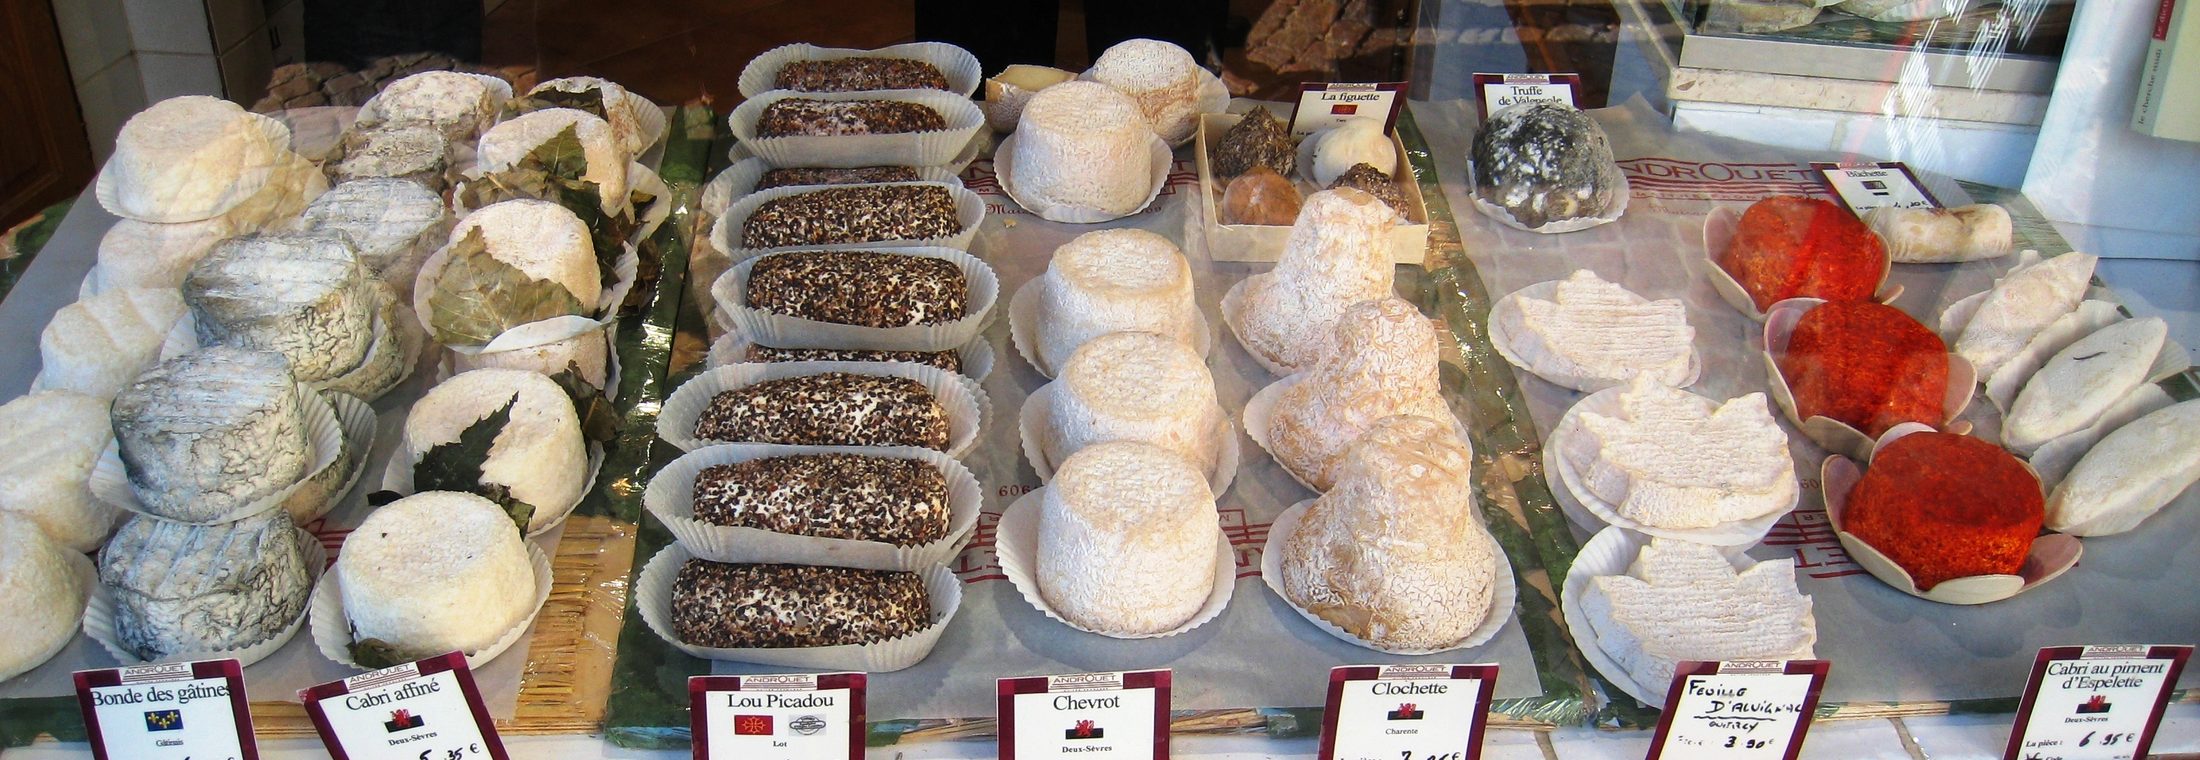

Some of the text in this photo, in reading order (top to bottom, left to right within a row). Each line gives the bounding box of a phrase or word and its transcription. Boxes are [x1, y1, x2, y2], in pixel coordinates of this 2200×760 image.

[1321, 92, 1380, 103] La figuette
[1511, 86, 1543, 96] Truffe
[1498, 96, 1512, 106] de
[1618, 161, 1814, 183] NDROUET
[998, 484, 1033, 498] 909
[123, 663, 187, 677] ANDROUET
[348, 662, 411, 684] ANDROUET
[1384, 665, 1447, 673] ANDROUET
[2047, 661, 2164, 677] Cabri au piment
[744, 674, 811, 684] ANDROUET
[1052, 673, 1117, 685] ANDROUET
[2062, 675, 2144, 692] d'Espelette
[91, 682, 231, 707] Bonde des gâtines
[345, 687, 391, 711] Cabri
[393, 676, 441, 701] affiné
[1371, 681, 1448, 696] Clochette
[727, 692, 835, 709] Lou Picadou
[1053, 694, 1120, 711] Chevrot
[2063, 716, 2109, 724] Deux-Sèvres
[387, 730, 438, 747] Deux-Sèvres
[1385, 727, 1419, 736] Charente
[772, 740, 788, 748] Lot
[2025, 740, 2038, 748] La
[2126, 732, 2135, 743] €
[469, 742, 481, 755] €
[1061, 744, 1113, 754] Deux-Sèvres
